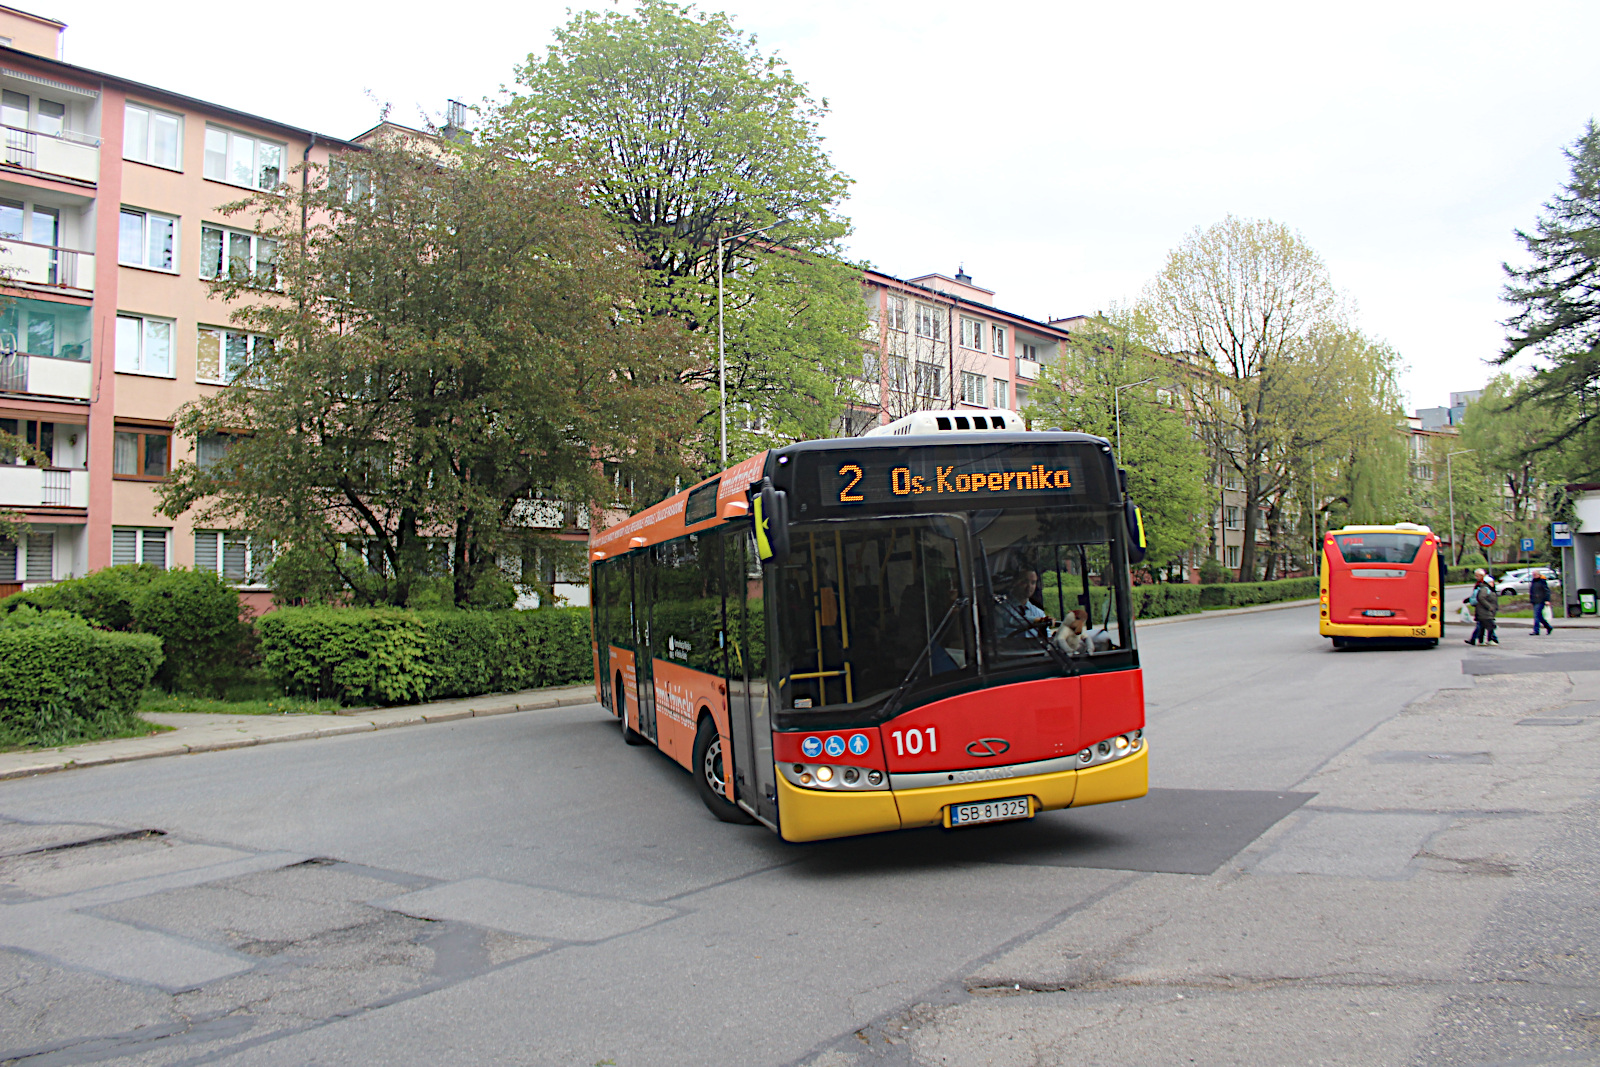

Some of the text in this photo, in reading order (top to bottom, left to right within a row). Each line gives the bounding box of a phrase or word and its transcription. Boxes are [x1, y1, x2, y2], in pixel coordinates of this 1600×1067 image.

[838, 464, 864, 502] 2
[936, 464, 1072, 494] Kopernika
[1523, 540, 1532, 551] P
[1411, 628, 1426, 637] 158
[891, 727, 937, 756] 101
[957, 766, 1014, 784] SOLARIS
[960, 800, 1026, 822] SB 81325
